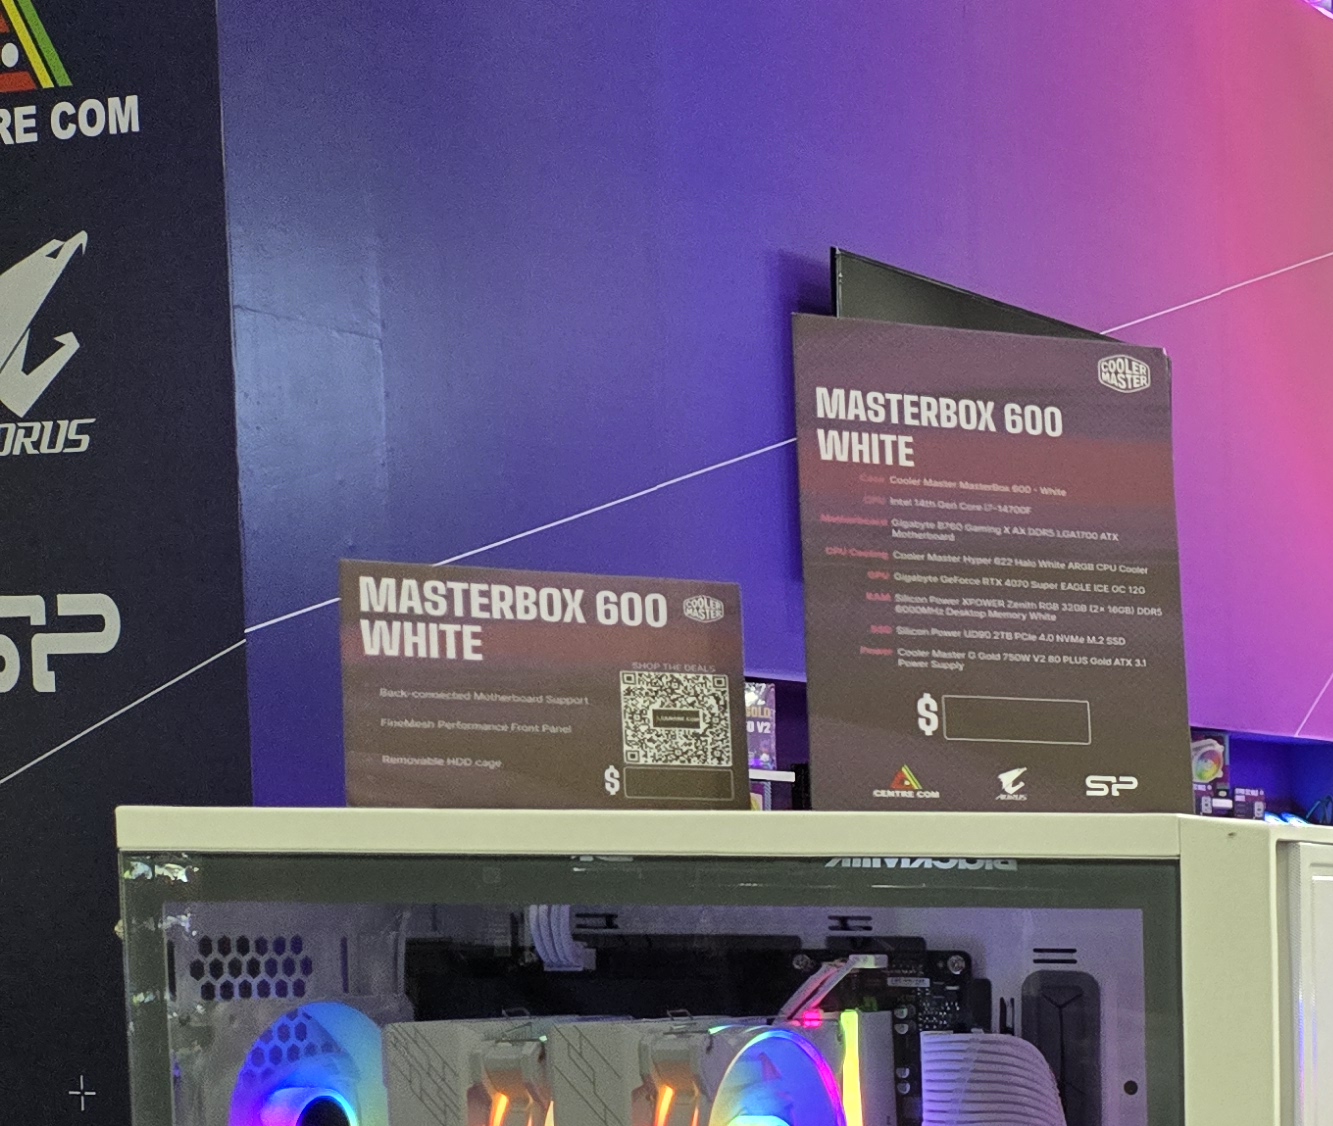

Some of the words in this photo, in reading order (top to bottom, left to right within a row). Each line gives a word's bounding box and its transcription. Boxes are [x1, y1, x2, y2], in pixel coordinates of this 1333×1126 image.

[51, 95, 139, 140] COM
[1100, 358, 1147, 377] COOLER
[1101, 372, 1149, 389] MASTER
[815, 386, 997, 432] MASTERBOX
[1004, 402, 1064, 438] 600
[816, 428, 916, 467] WHITE
[359, 575, 586, 623] MASTERBOX
[596, 590, 668, 628] 600
[685, 596, 722, 610] COOLER
[685, 608, 722, 620] MASTER
[360, 618, 483, 661] WHITE
[380, 687, 472, 701] Back-connected
[473, 691, 543, 704] Motherboard
[546, 695, 589, 707] Support
[380, 717, 435, 729] FineMesh
[437, 719, 509, 732] Performance
[510, 723, 540, 733] Front
[541, 724, 572, 734] Panel
[382, 754, 445, 767] Removable
[447, 757, 473, 767] HDD
[474, 759, 502, 770] cage
[872, 789, 914, 798] CENTRE
[917, 790, 940, 799] COM
[1085, 774, 1139, 796] SP
